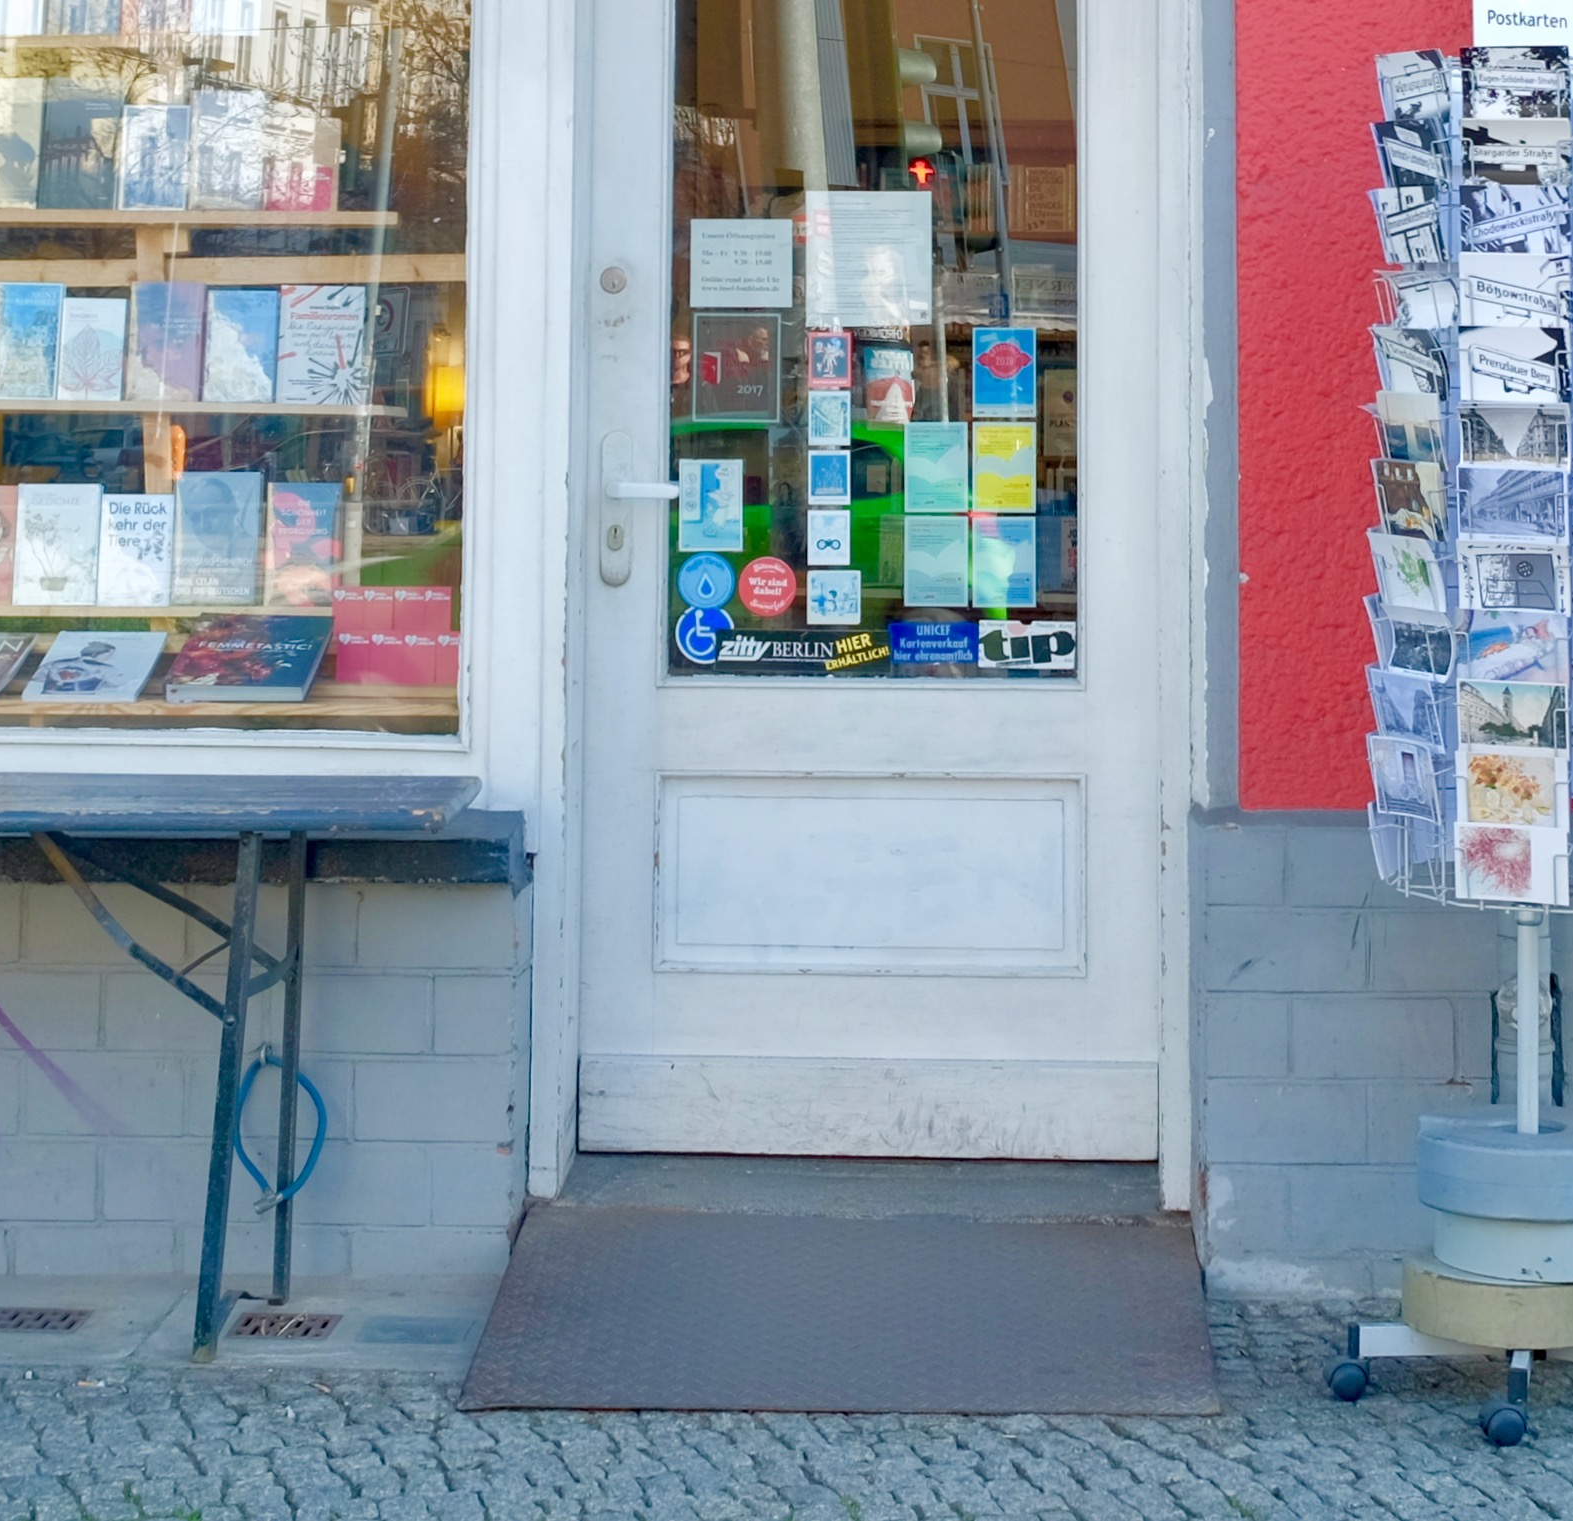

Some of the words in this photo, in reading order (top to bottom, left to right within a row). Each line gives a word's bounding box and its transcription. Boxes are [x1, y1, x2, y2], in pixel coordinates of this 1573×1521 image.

[1487, 9, 1569, 29] Postkarten
[1473, 148, 1520, 159] Stargarder
[1479, 354, 1528, 375] Prenzlauer
[1530, 367, 1551, 384] Berg
[736, 384, 764, 397] 2017
[109, 502, 132, 515] Die
[134, 501, 168, 514] Rück
[108, 517, 138, 531] kehr
[142, 517, 167, 531] der
[108, 533, 141, 548] Tiere
[748, 577, 767, 587] Wir
[767, 577, 788, 588] sind
[753, 586, 782, 597] dabei!
[916, 624, 951, 636] UNICEF
[198, 640, 314, 652] FEMMETASTIC!
[718, 634, 772, 660] zitty
[772, 640, 834, 658] BERLIN
[835, 633, 873, 655] HIER
[899, 636, 969, 648] Kartenverkauf
[978, 630, 1076, 664] tip
[824, 645, 891, 672] ERHÄLTLICH!
[893, 649, 913, 661] hier
[914, 649, 974, 662] ehrenamtlich
